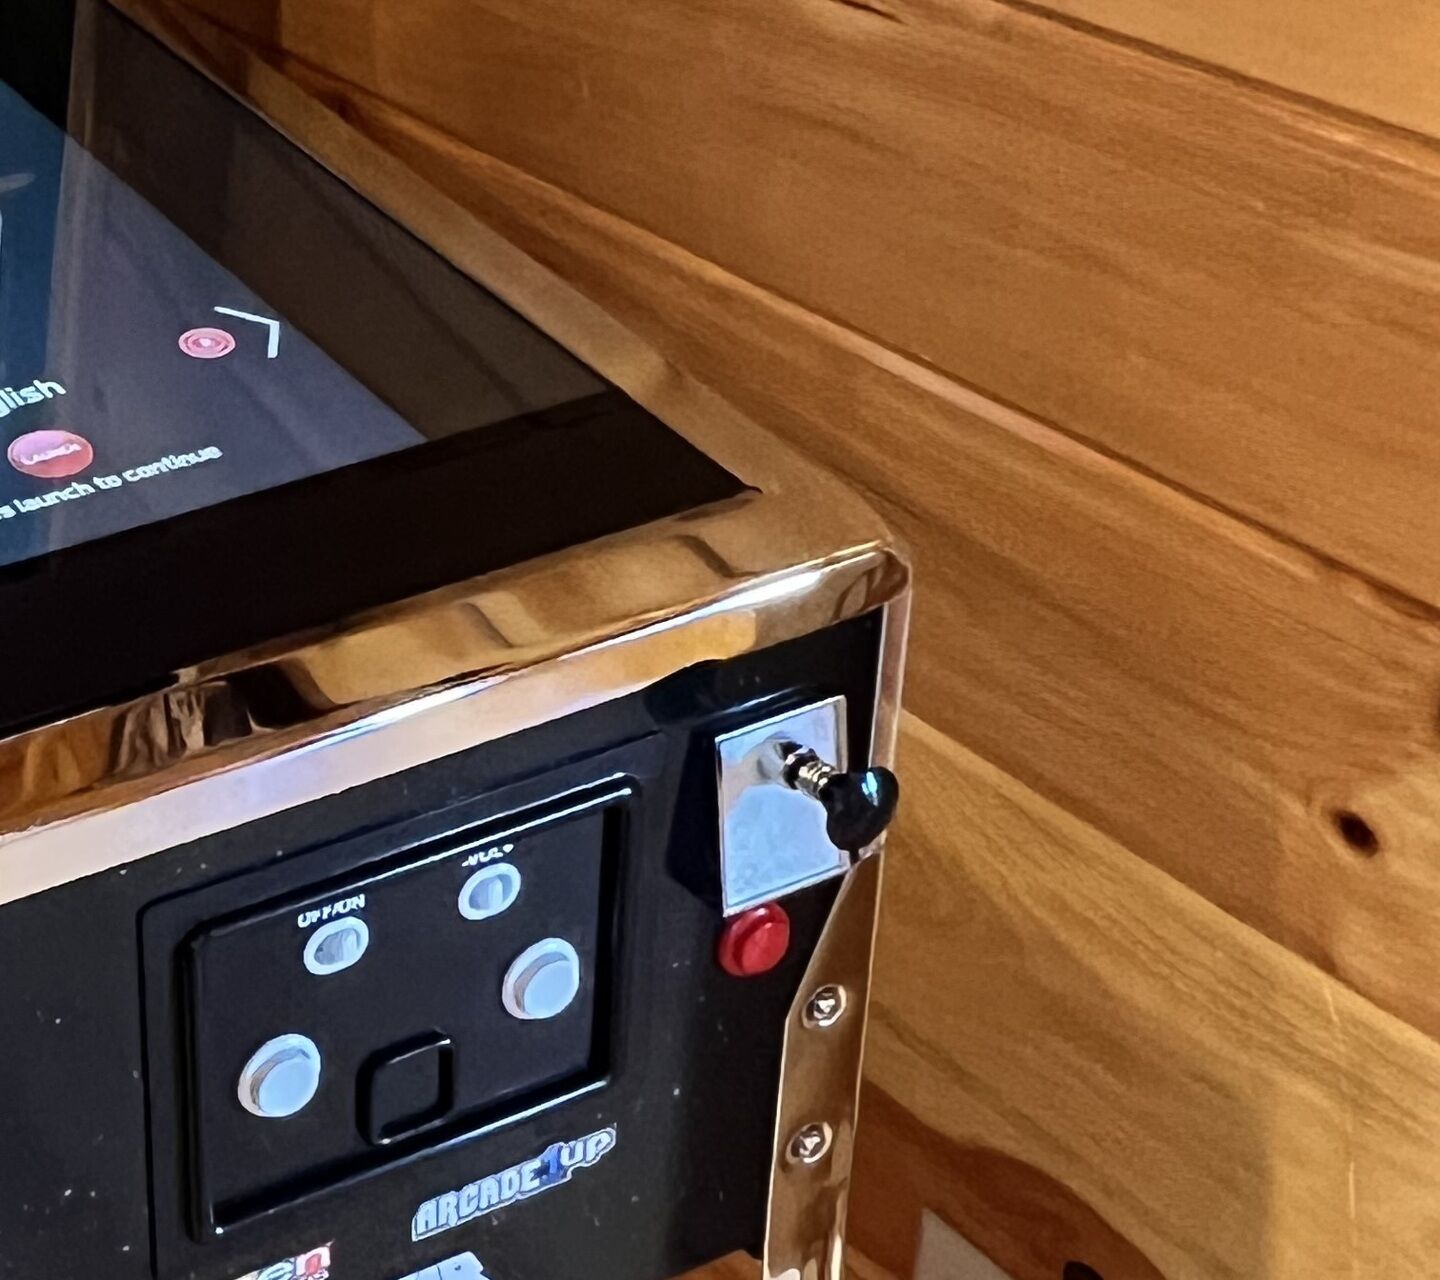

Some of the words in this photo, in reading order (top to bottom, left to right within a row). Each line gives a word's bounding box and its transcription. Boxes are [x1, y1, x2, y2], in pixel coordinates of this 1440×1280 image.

[13, 481, 96, 514] launch
[93, 475, 123, 491] to
[122, 446, 224, 482] continue
